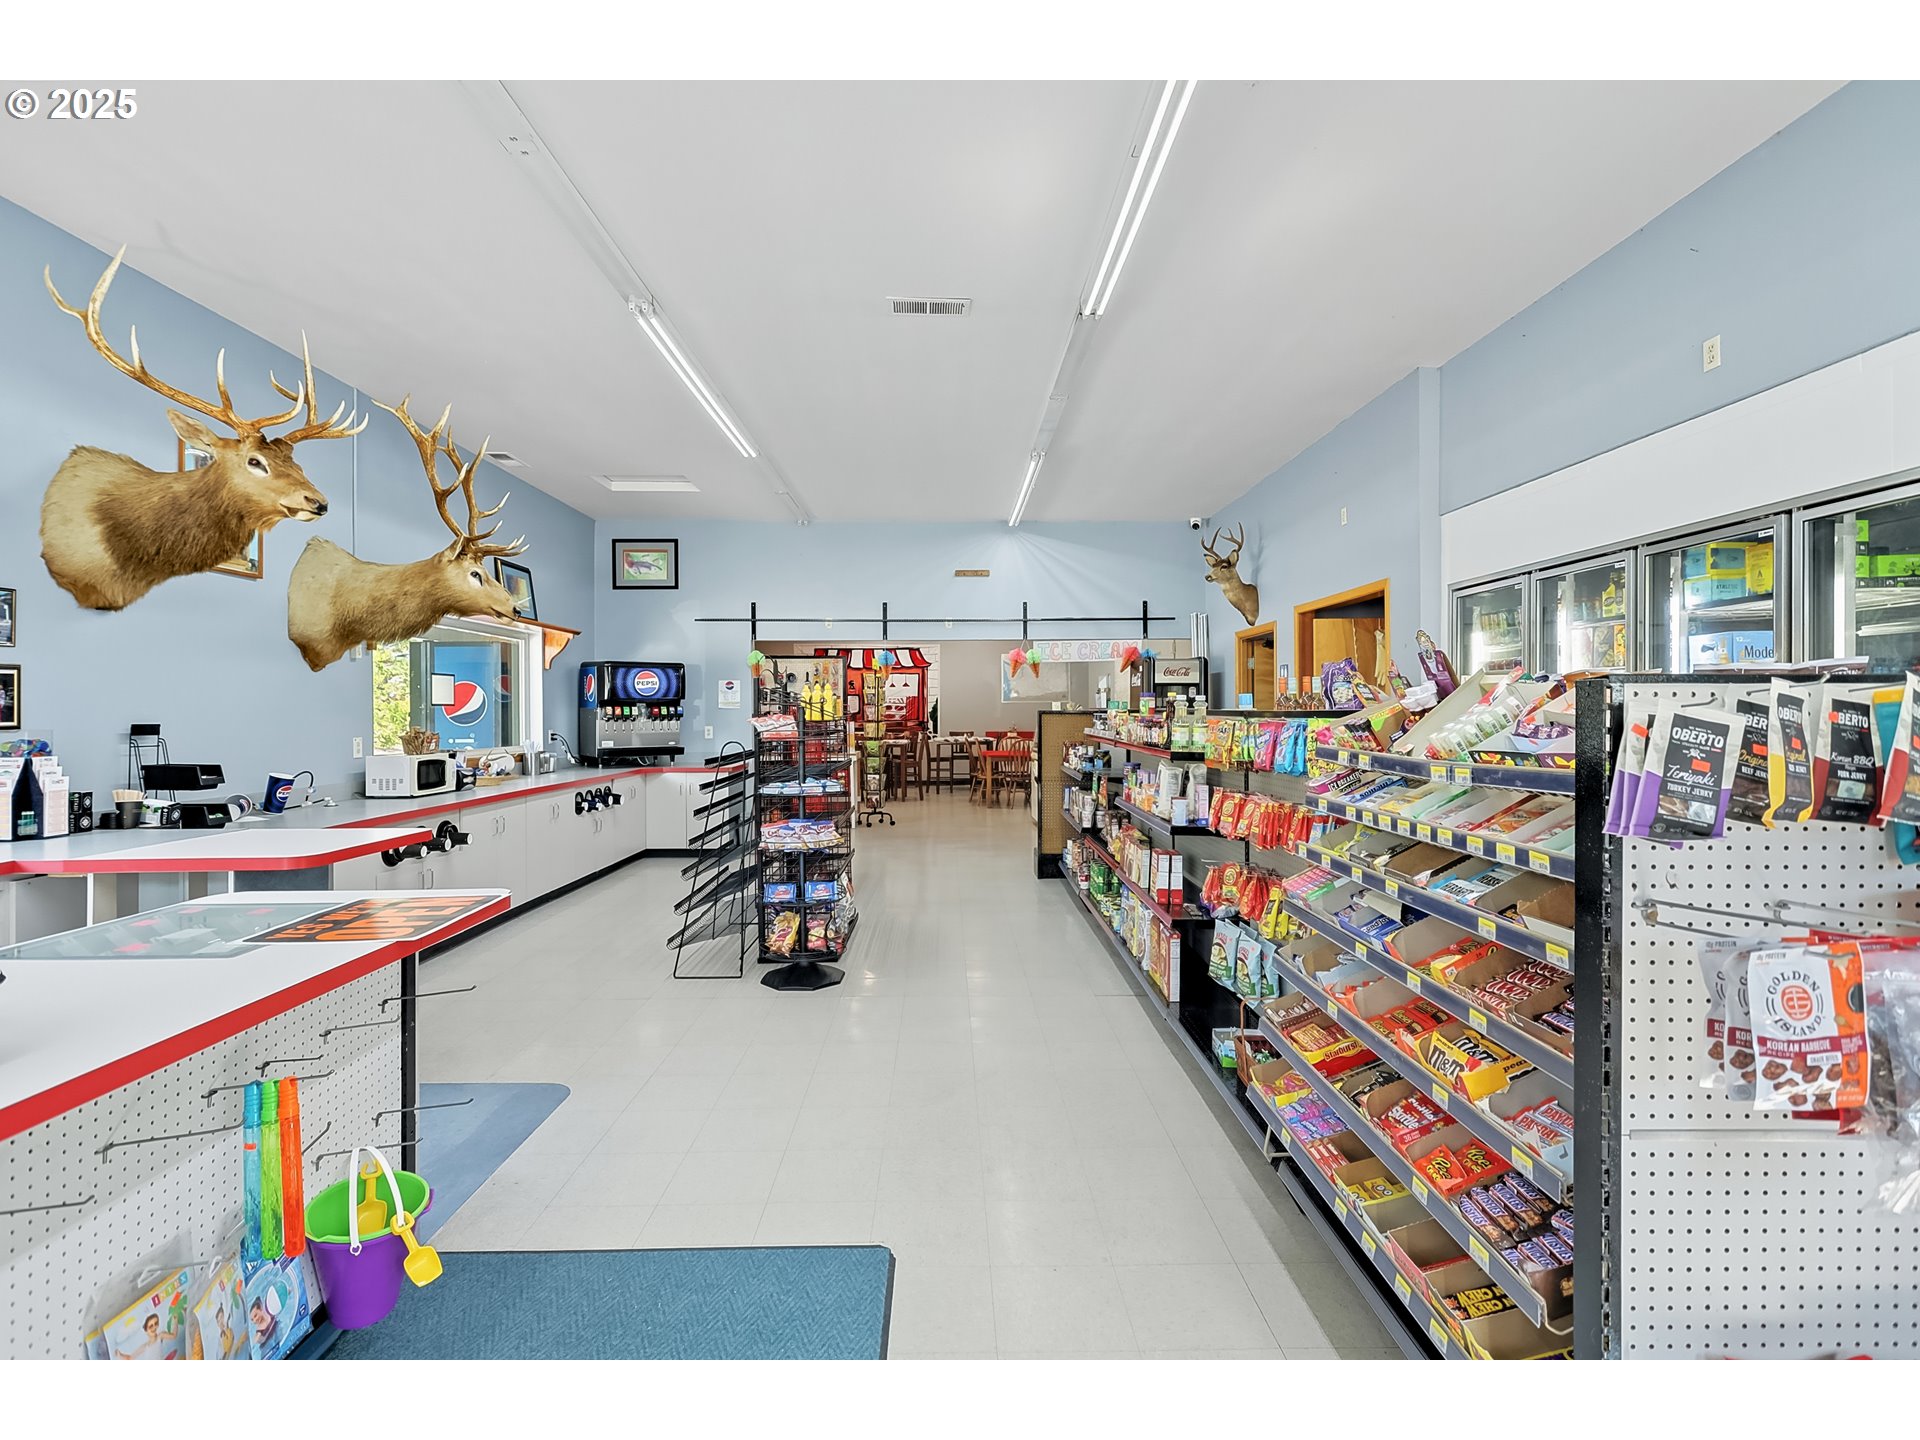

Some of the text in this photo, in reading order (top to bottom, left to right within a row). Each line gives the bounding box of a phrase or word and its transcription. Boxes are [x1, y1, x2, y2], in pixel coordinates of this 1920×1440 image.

[1037, 642, 1071, 661] ICE
[1838, 712, 1868, 728] BERTO
[1672, 726, 1725, 748] OBERTO
[1853, 755, 1874, 766] BBQ
[1667, 764, 1717, 786] Teriyaki
[1667, 782, 1713, 799] TURKEY JERKY
[314, 896, 488, 941] OPEN
[266, 921, 328, 940] YES
[1767, 971, 1820, 995] GOLDEN
[1774, 1016, 1822, 1036] ISLAND
[1325, 1041, 1358, 1060] Starburst
[1766, 1039, 1799, 1052] KOREAN
[1457, 1287, 1493, 1306] CHEW
[1466, 1300, 1503, 1318] CHEW
